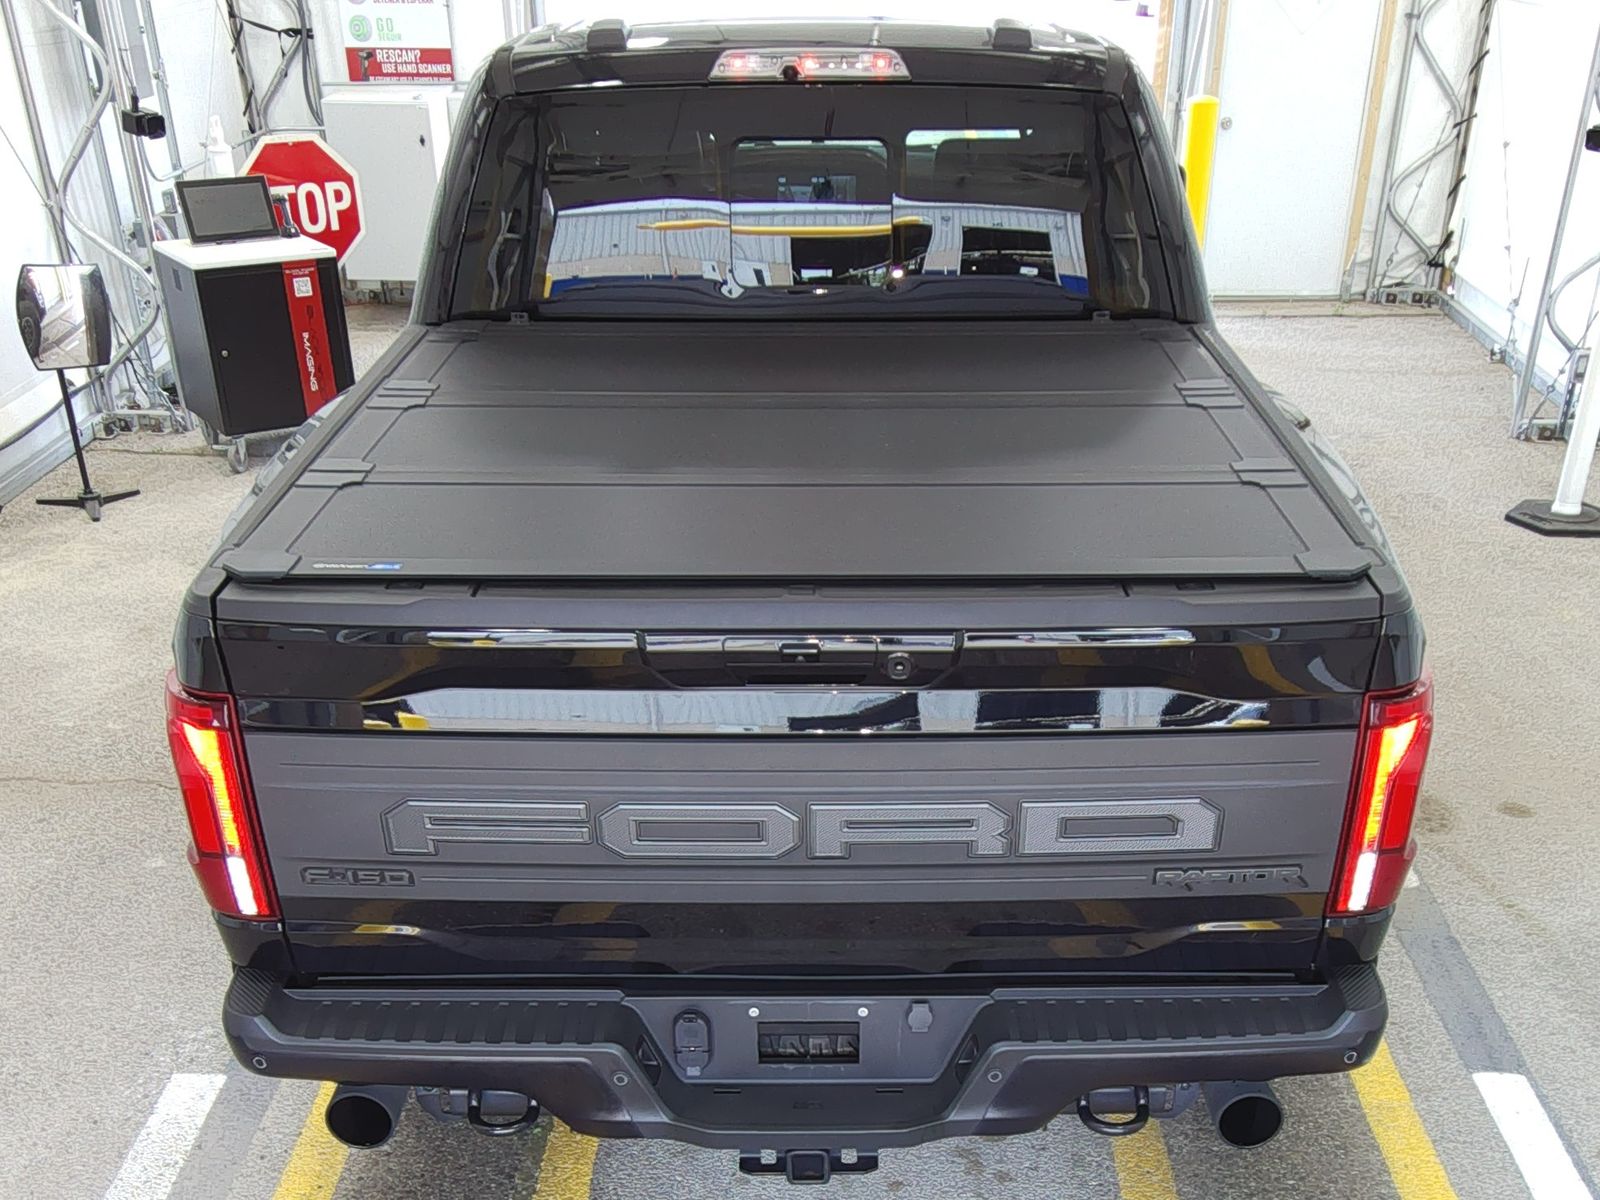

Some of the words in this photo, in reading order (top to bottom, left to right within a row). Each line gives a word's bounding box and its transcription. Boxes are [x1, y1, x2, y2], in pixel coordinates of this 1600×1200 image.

[376, 17, 394, 32] GO
[375, 49, 421, 63] RESCAN?
[381, 63, 397, 73] USE
[397, 64, 417, 73] HAND
[418, 64, 452, 74] SCANNER
[269, 181, 352, 234] TOP
[302, 332, 319, 391] IMAGING
[382, 798, 1222, 859] FORD
[1152, 864, 1309, 891] RAPTOR
